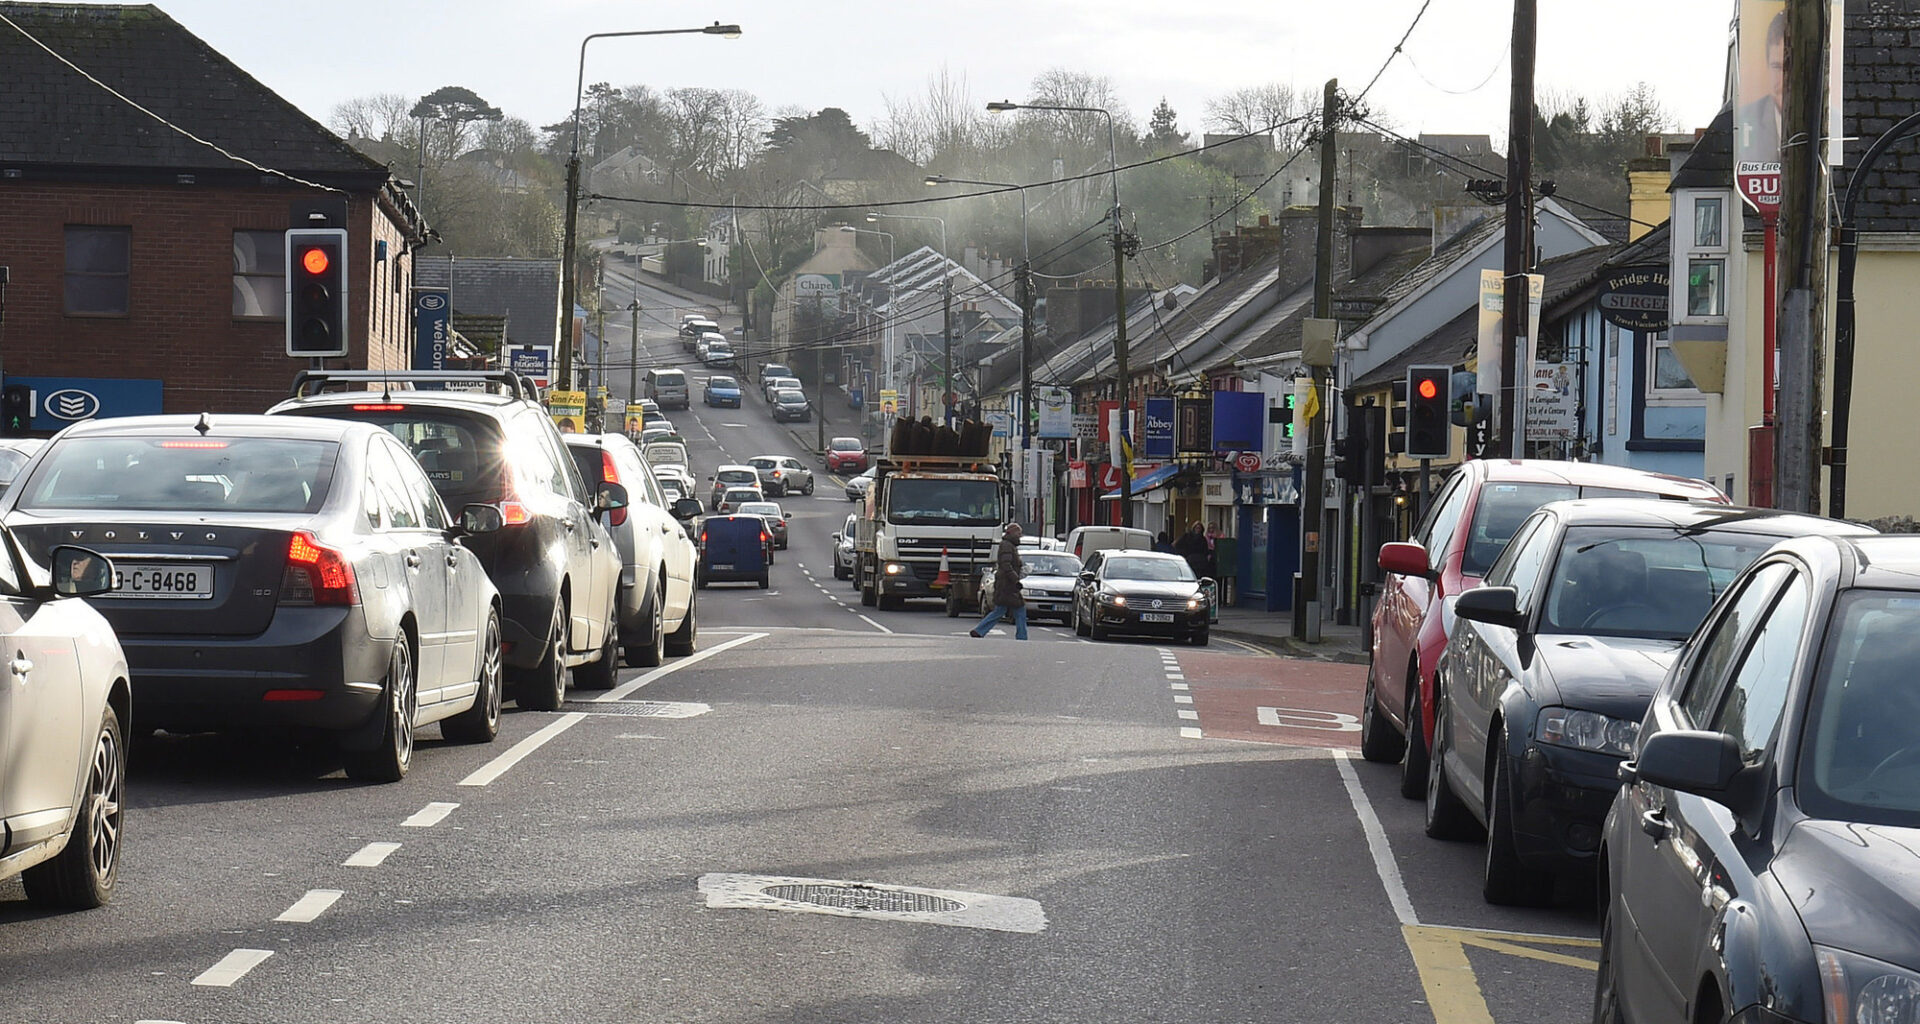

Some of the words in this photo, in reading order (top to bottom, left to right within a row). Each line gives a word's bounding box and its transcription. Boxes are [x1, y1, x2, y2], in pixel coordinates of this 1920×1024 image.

[1748, 178, 1780, 194] BU
[801, 280, 835, 290] Chapel
[1609, 273, 1649, 290] Bridge
[1614, 314, 1634, 326] Travel
[550, 394, 567, 404] Sinn
[568, 394, 585, 404] Féin
[1147, 420, 1173, 431] Abbey
[71, 530, 216, 541] VOLVO
